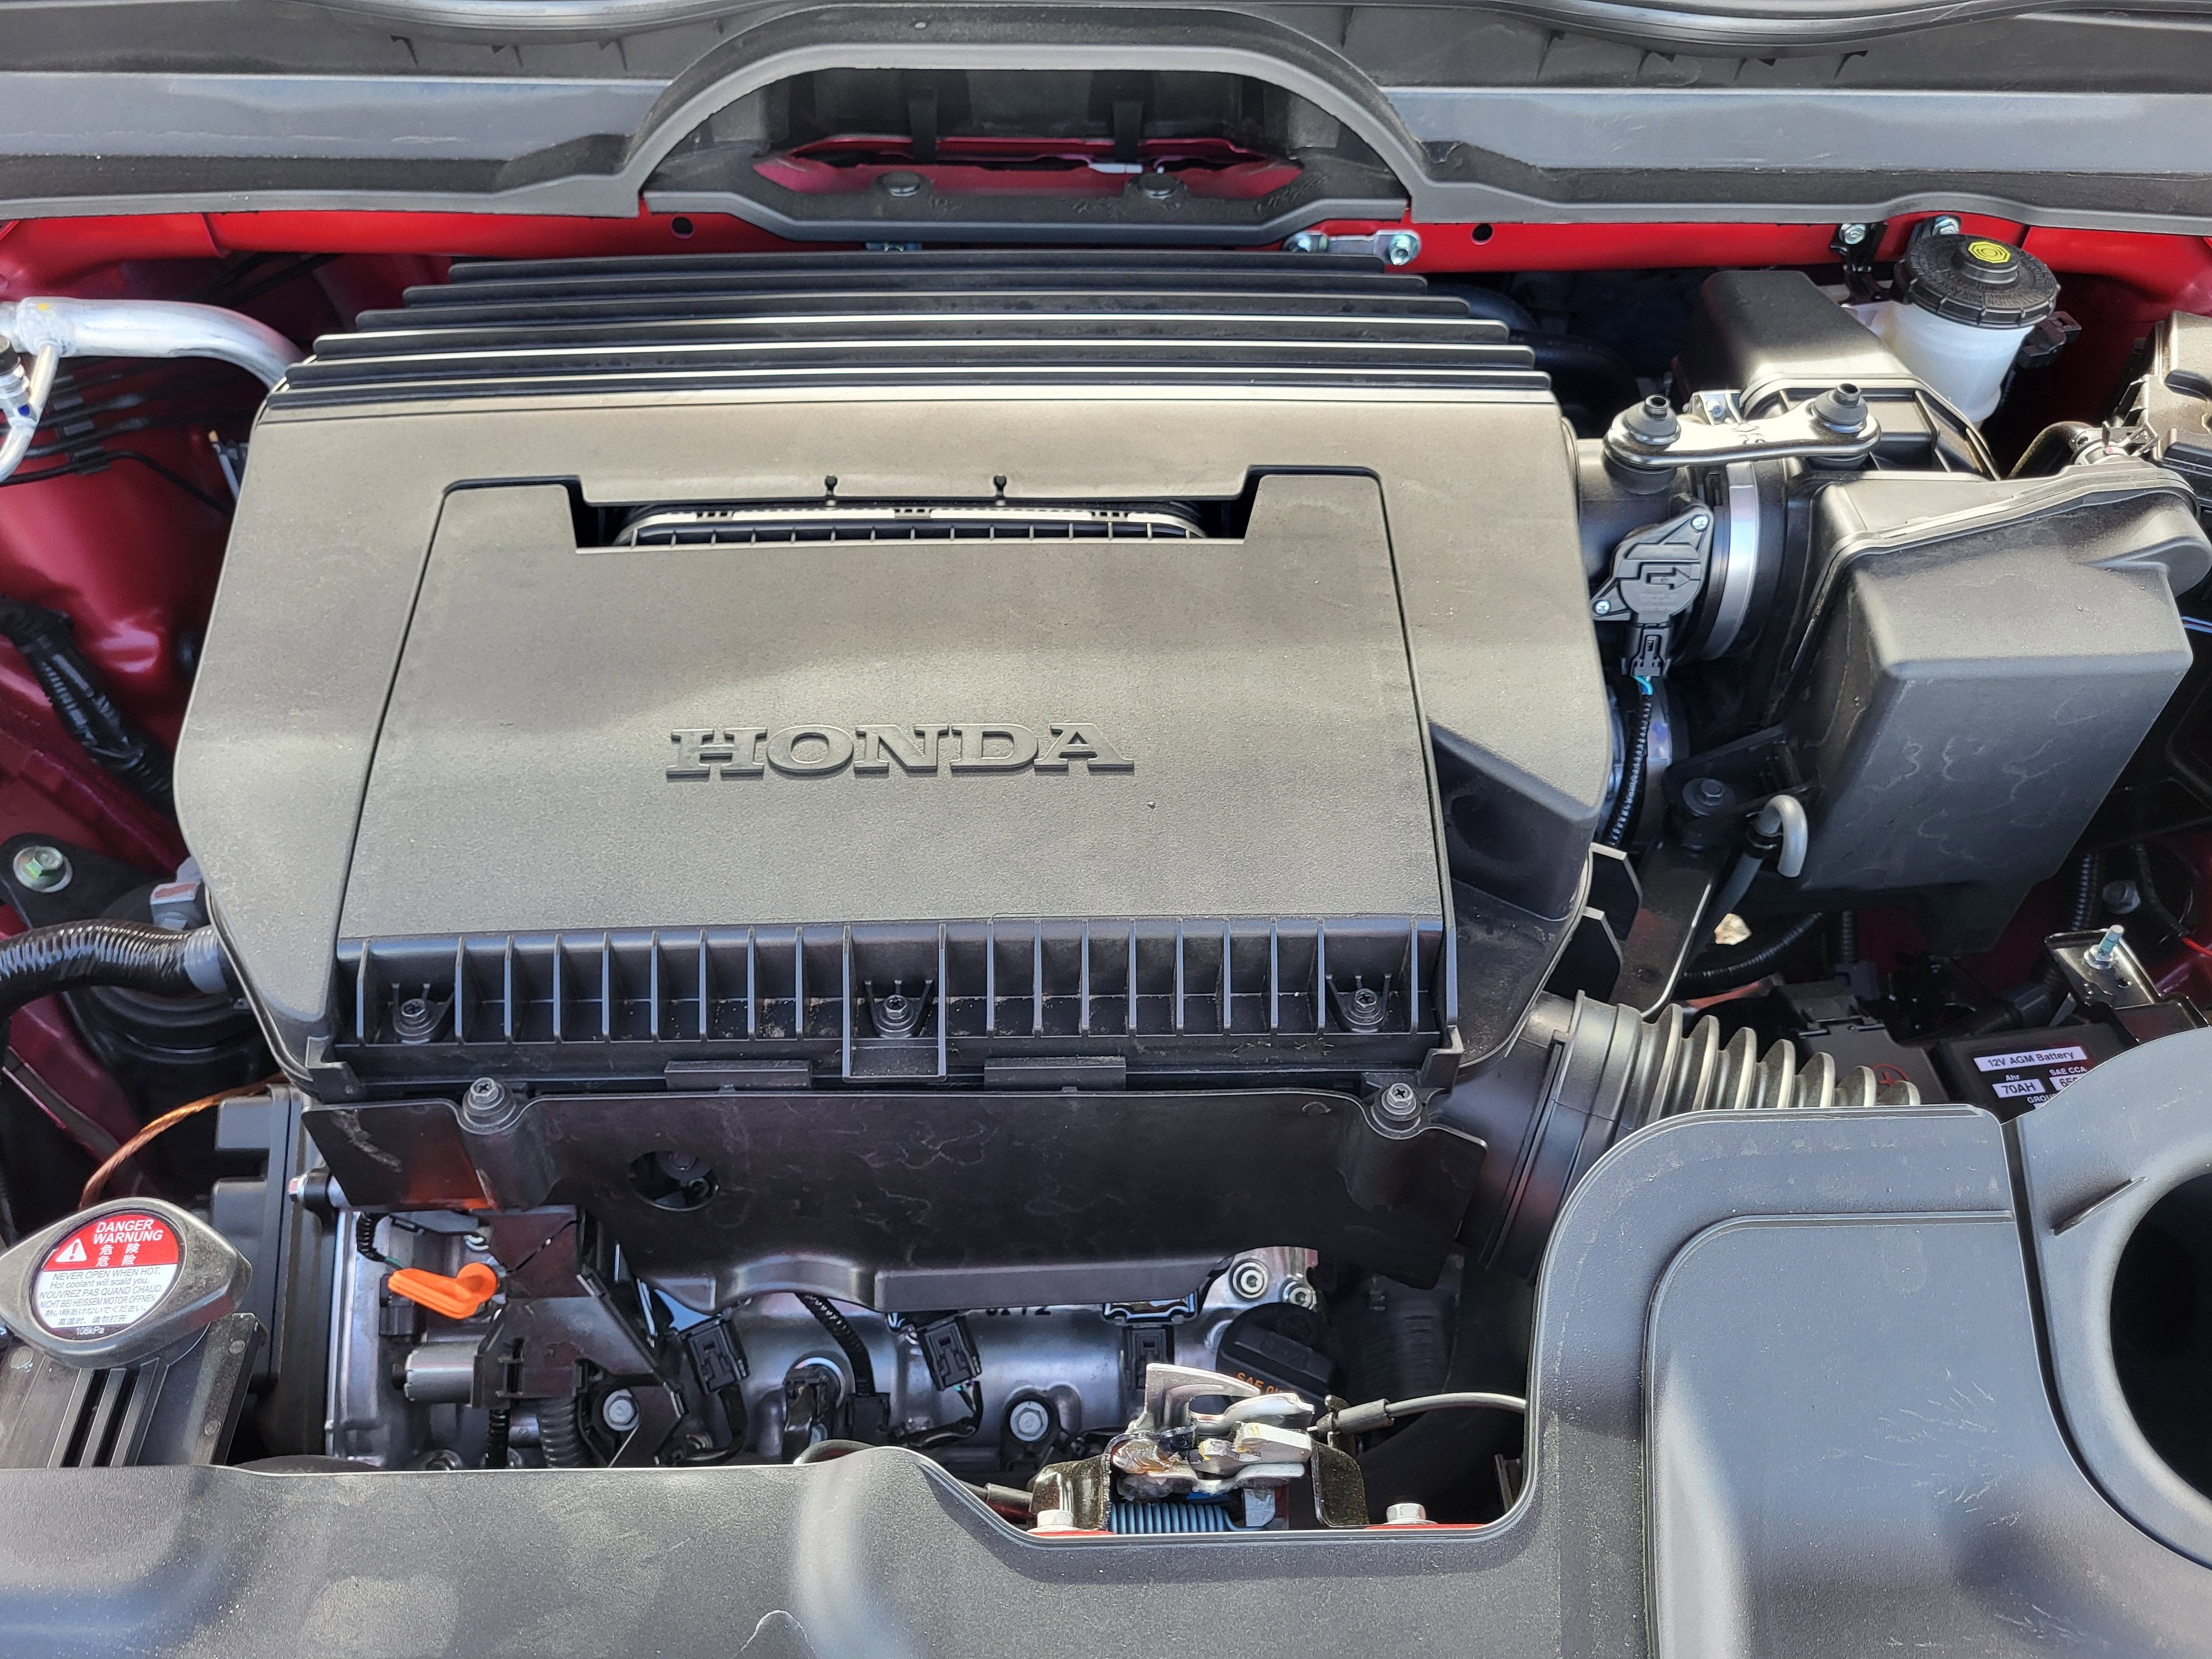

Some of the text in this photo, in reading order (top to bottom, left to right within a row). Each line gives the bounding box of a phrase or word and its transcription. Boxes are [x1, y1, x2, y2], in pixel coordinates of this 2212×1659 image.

[667, 723, 1135, 779] HONDA
[1987, 1051, 2074, 1067] 12V AGM Battery
[2049, 1068, 2068, 1076] SAE
[2001, 1082, 2037, 1095] 70AH
[95, 1219, 154, 1233] DANGER
[93, 1230, 163, 1244] WARNUNG
[53, 1267, 160, 1281] NEVER OPEN WHEN HOT.
[66, 1280, 93, 1288] coolant
[110, 1277, 131, 1286] scald
[132, 1277, 149, 1286] you.
[39, 1285, 163, 1300] N'OUVREZ PAS QUAND CHAUD.
[72, 1297, 102, 1306] HEISSEM
[103, 1296, 128, 1305] MOTOR
[75, 1326, 105, 1335] 108kPa
